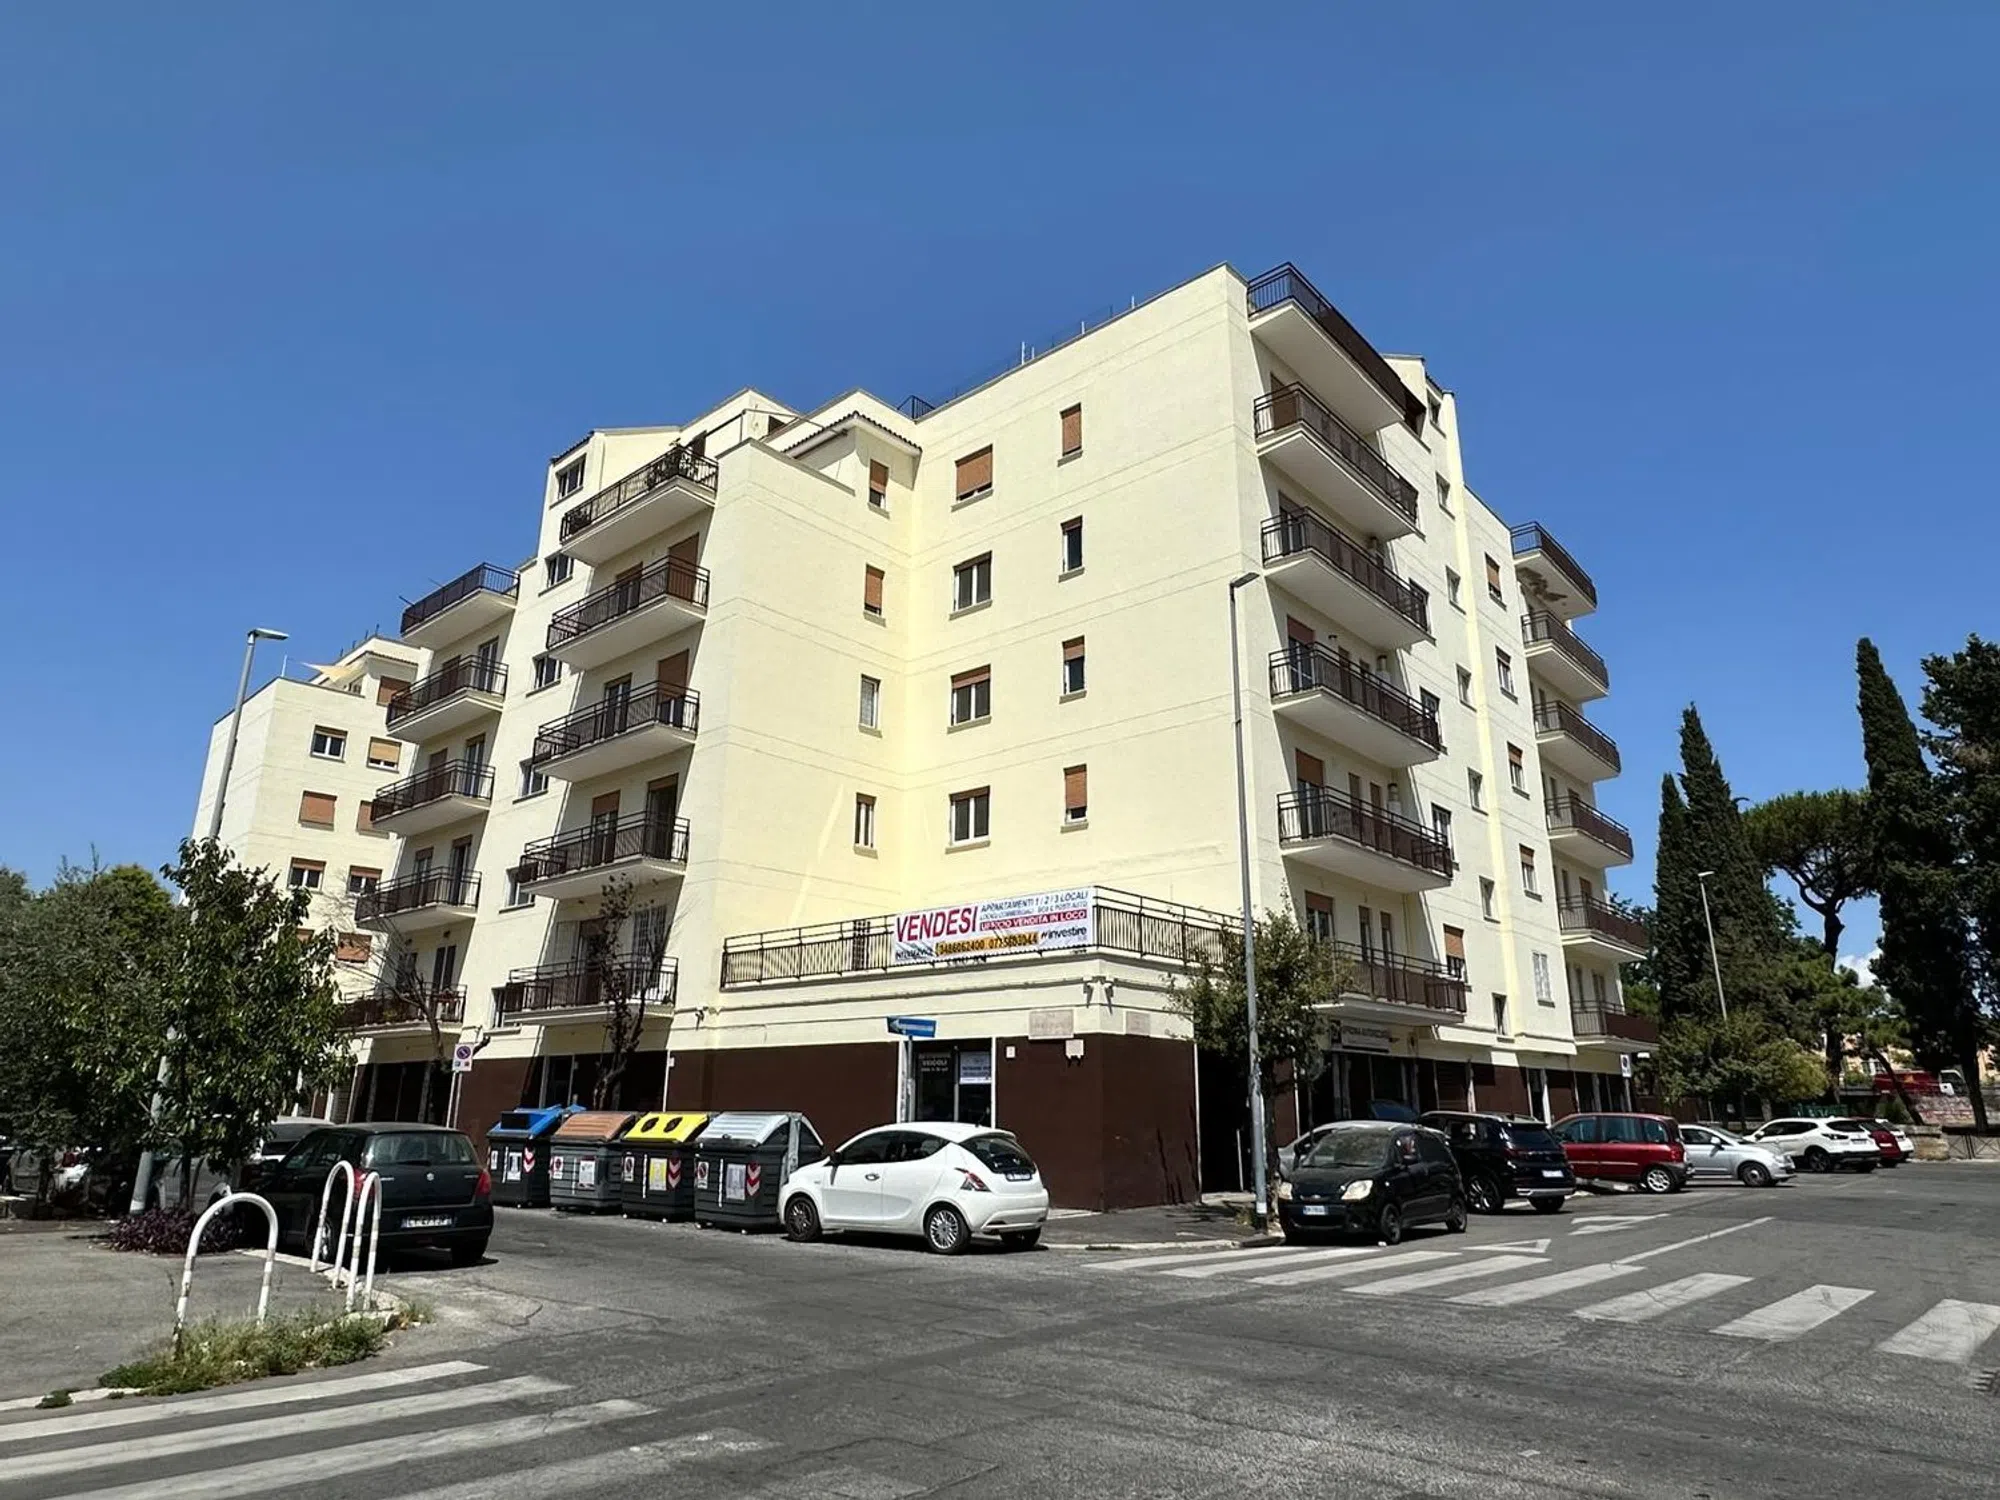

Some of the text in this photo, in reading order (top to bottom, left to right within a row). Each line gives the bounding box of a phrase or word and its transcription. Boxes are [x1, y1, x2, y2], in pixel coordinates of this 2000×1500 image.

[1060, 891, 1089, 902] LOCALI
[896, 906, 978, 942] VENDESI
[1013, 915, 1049, 927] VENDITA
[1050, 914, 1060, 923] IN
[1061, 910, 1086, 921] LOCO
